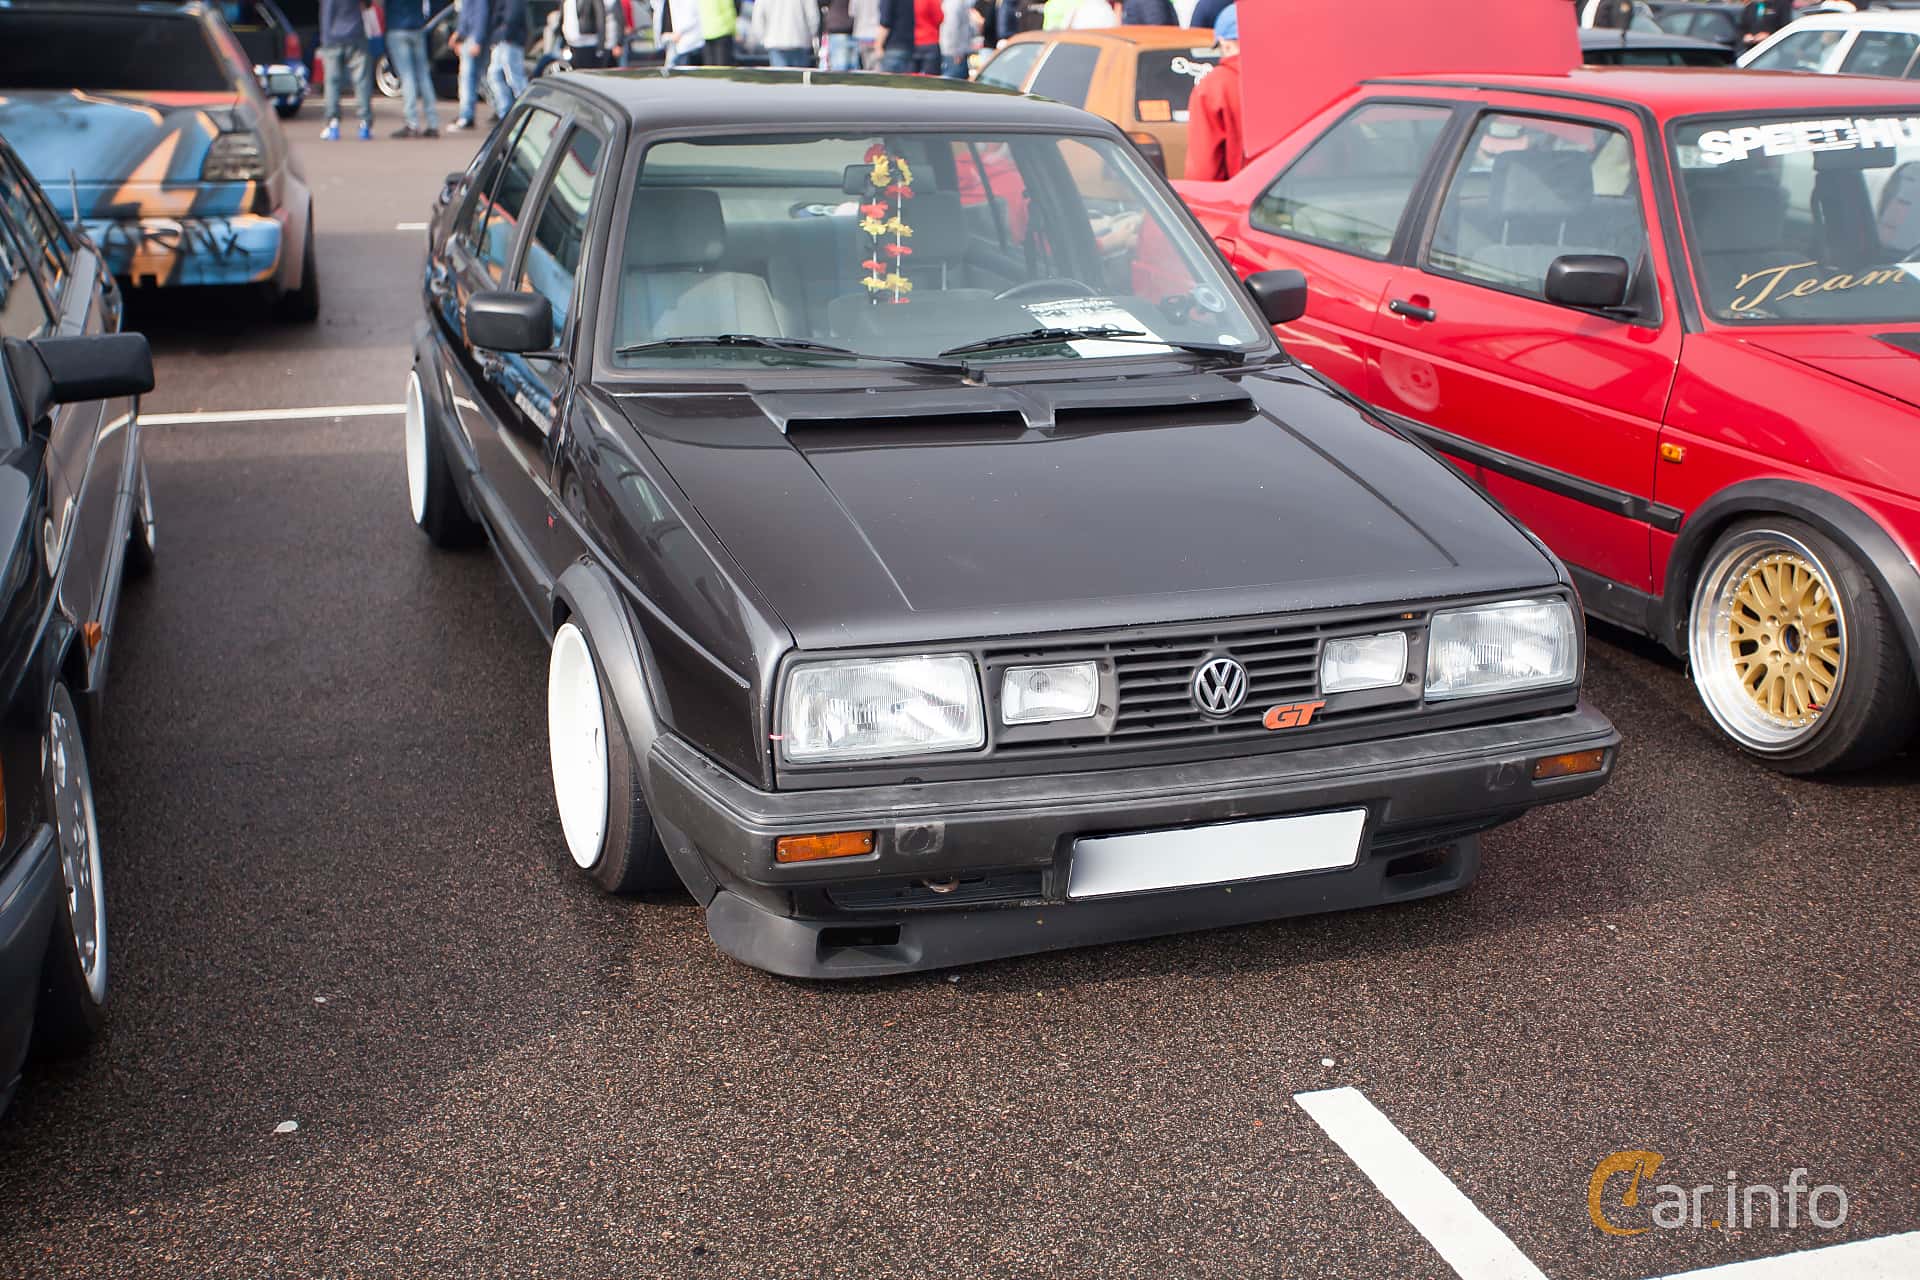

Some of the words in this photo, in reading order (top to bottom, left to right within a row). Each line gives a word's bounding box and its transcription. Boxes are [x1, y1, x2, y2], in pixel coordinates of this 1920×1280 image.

[1731, 261, 1905, 312] Team
[1196, 659, 1247, 714] VW
[1263, 701, 1327, 730] GT
